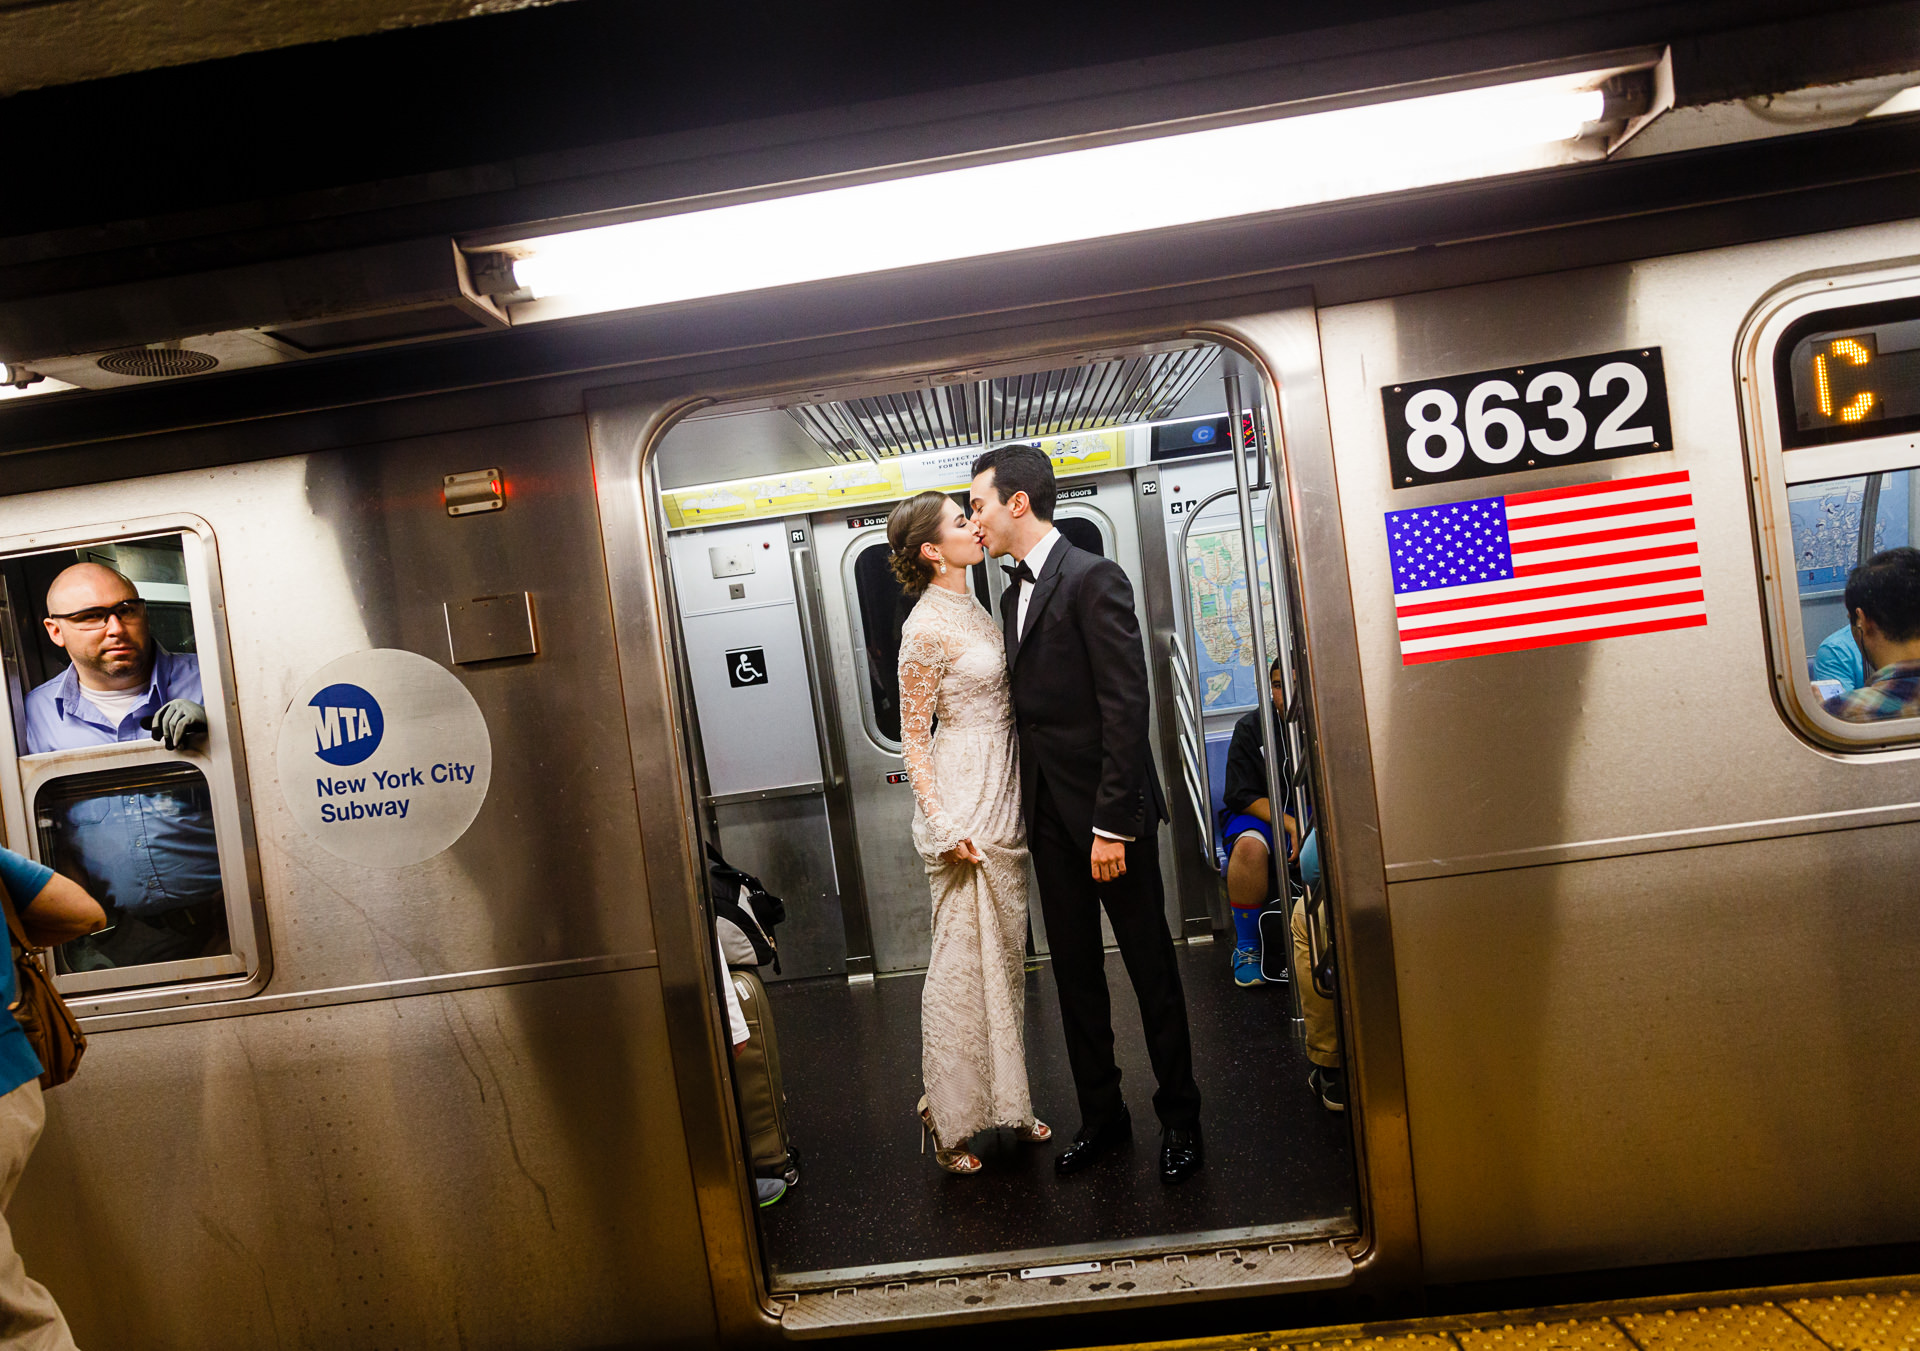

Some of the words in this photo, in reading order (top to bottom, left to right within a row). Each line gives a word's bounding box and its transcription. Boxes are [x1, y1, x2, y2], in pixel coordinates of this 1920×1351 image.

[1814, 338, 1872, 421] C
[1404, 362, 1655, 473] 8632
[938, 454, 969, 463] PERFECT
[1070, 488, 1092, 498] doors
[1142, 483, 1157, 493] R2
[863, 518, 875, 526] Do
[792, 531, 804, 541] R1
[307, 705, 373, 753] MTA
[316, 777, 367, 798] New
[372, 767, 425, 790] York
[430, 762, 475, 785] City
[320, 798, 410, 823] Subway
